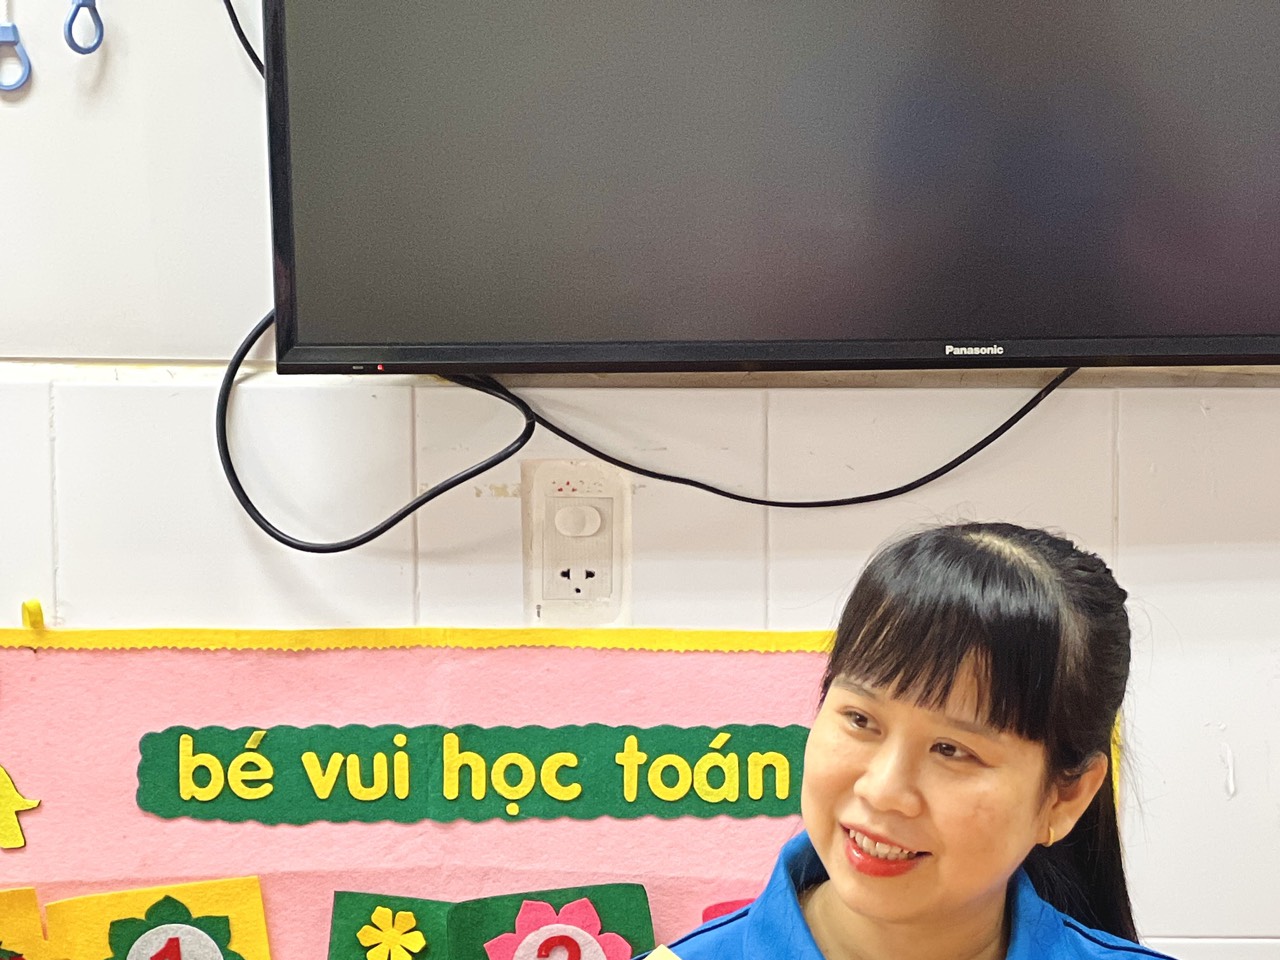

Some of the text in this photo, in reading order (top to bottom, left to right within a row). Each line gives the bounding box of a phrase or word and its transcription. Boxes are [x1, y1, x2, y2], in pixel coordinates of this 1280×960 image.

[945, 345, 1004, 355] Panasonic
[179, 730, 790, 816] bé vui học toán
